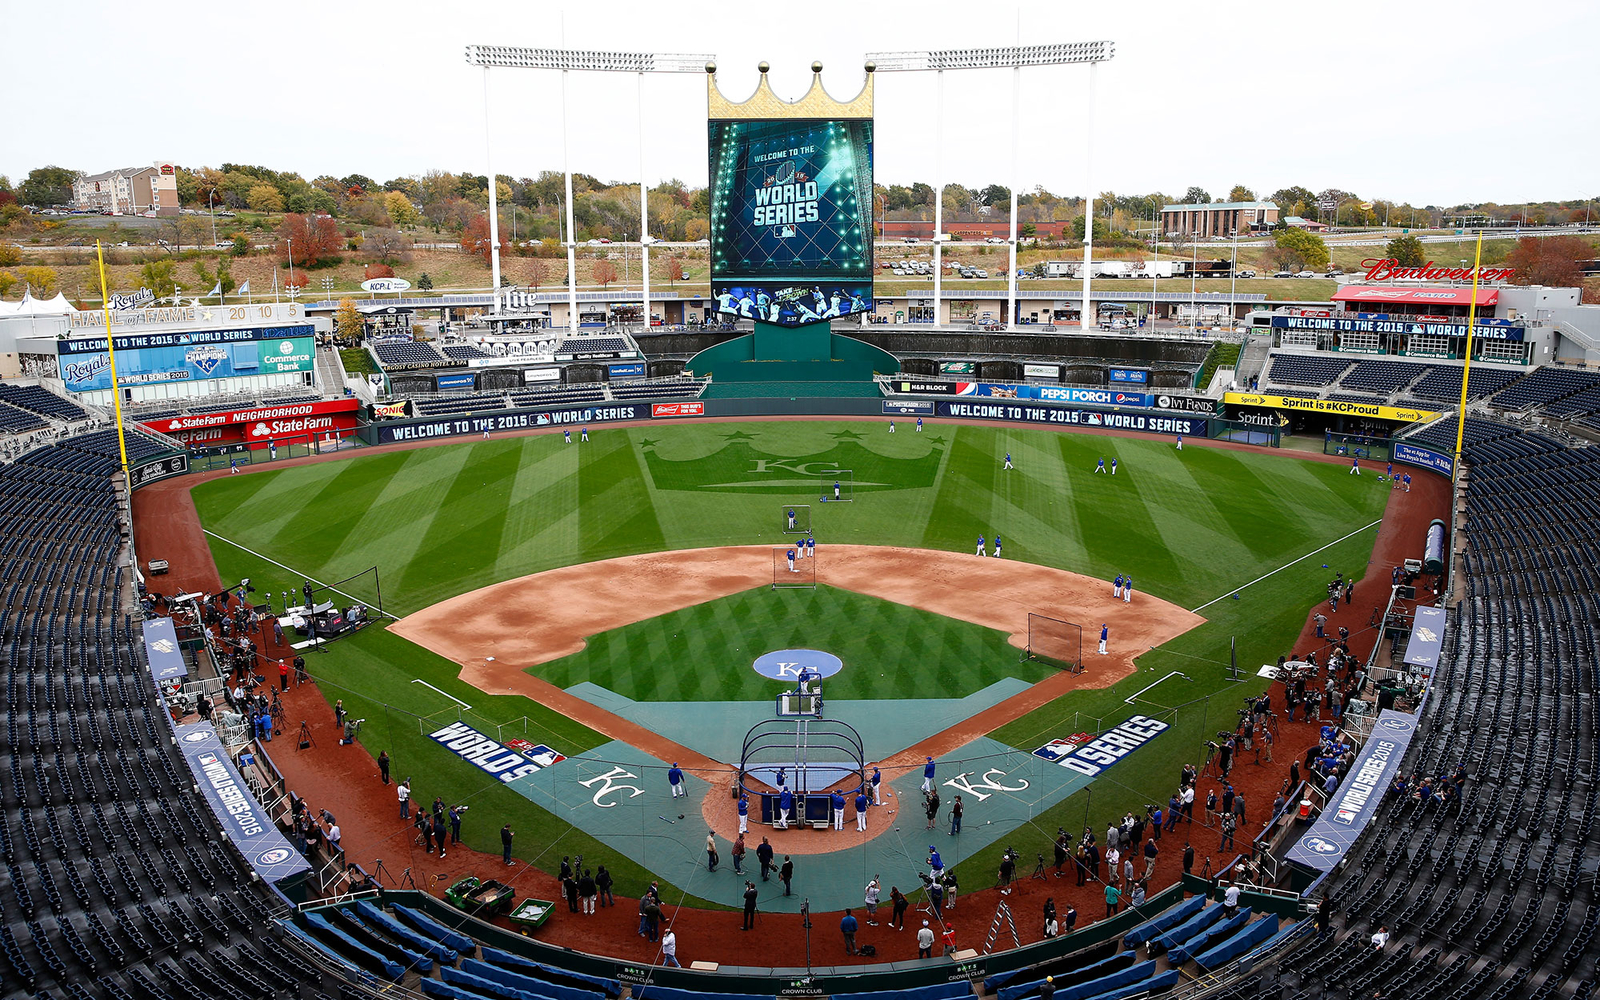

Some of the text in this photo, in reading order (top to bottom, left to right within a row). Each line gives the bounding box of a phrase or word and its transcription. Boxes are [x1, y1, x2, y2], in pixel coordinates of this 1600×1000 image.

[754, 145, 815, 163] WELCOME TO THE
[754, 180, 818, 207] WORLD
[753, 201, 819, 226] SERIES
[370, 282, 391, 290] KCP&L
[775, 287, 793, 297] TAKE
[1413, 291, 1457, 299] PATIO
[110, 287, 155, 311] Royals
[500, 285, 538, 311] Lite
[70, 312, 124, 327] HALL
[144, 307, 196, 323] FAME
[229, 307, 246, 320] 20
[259, 305, 273, 318] 10
[289, 304, 297, 317] 5
[1287, 317, 1507, 339] WELCOME TO THE 2015 WORLD SERIES
[69, 339, 112, 351] WELCOM
[116, 339, 128, 348] TO
[132, 337, 149, 347] THE
[151, 335, 173, 345] 2015
[190, 332, 221, 342] WORLD
[223, 330, 253, 340] SERIES
[185, 351, 228, 362] CHAMPIONS
[264, 354, 310, 364] Commerce
[64, 354, 112, 383] Royals
[277, 362, 299, 371] Bank
[1041, 388, 1111, 403] PEPSI PORCH
[1171, 397, 1213, 412] IVY FUNDS
[1241, 396, 1258, 404] Sprint
[232, 405, 313, 422] NEIGHBORHOOD
[375, 404, 404, 416] SONIC
[1282, 397, 1379, 415] Sprint is #KCProud
[1396, 410, 1414, 420] Sprint
[392, 407, 635, 441] WELCOME TO THE 2015 WORLD SERIES
[949, 404, 1191, 434] WELCOME TO THE 2015 WORLD SERIES
[1238, 411, 1274, 427] Sprint
[746, 458, 842, 476] KC
[1076, 715, 1168, 766] SERIES
[429, 721, 525, 779] WORLD
[942, 768, 1030, 802] KC
[1339, 740, 1395, 813] WORLD SERIES 2015
[577, 766, 645, 808] KC
[202, 761, 263, 836] WORLD SERIES 2015
[616, 973, 639, 982] CROWN
[948, 969, 986, 981] CROWN CLUB
